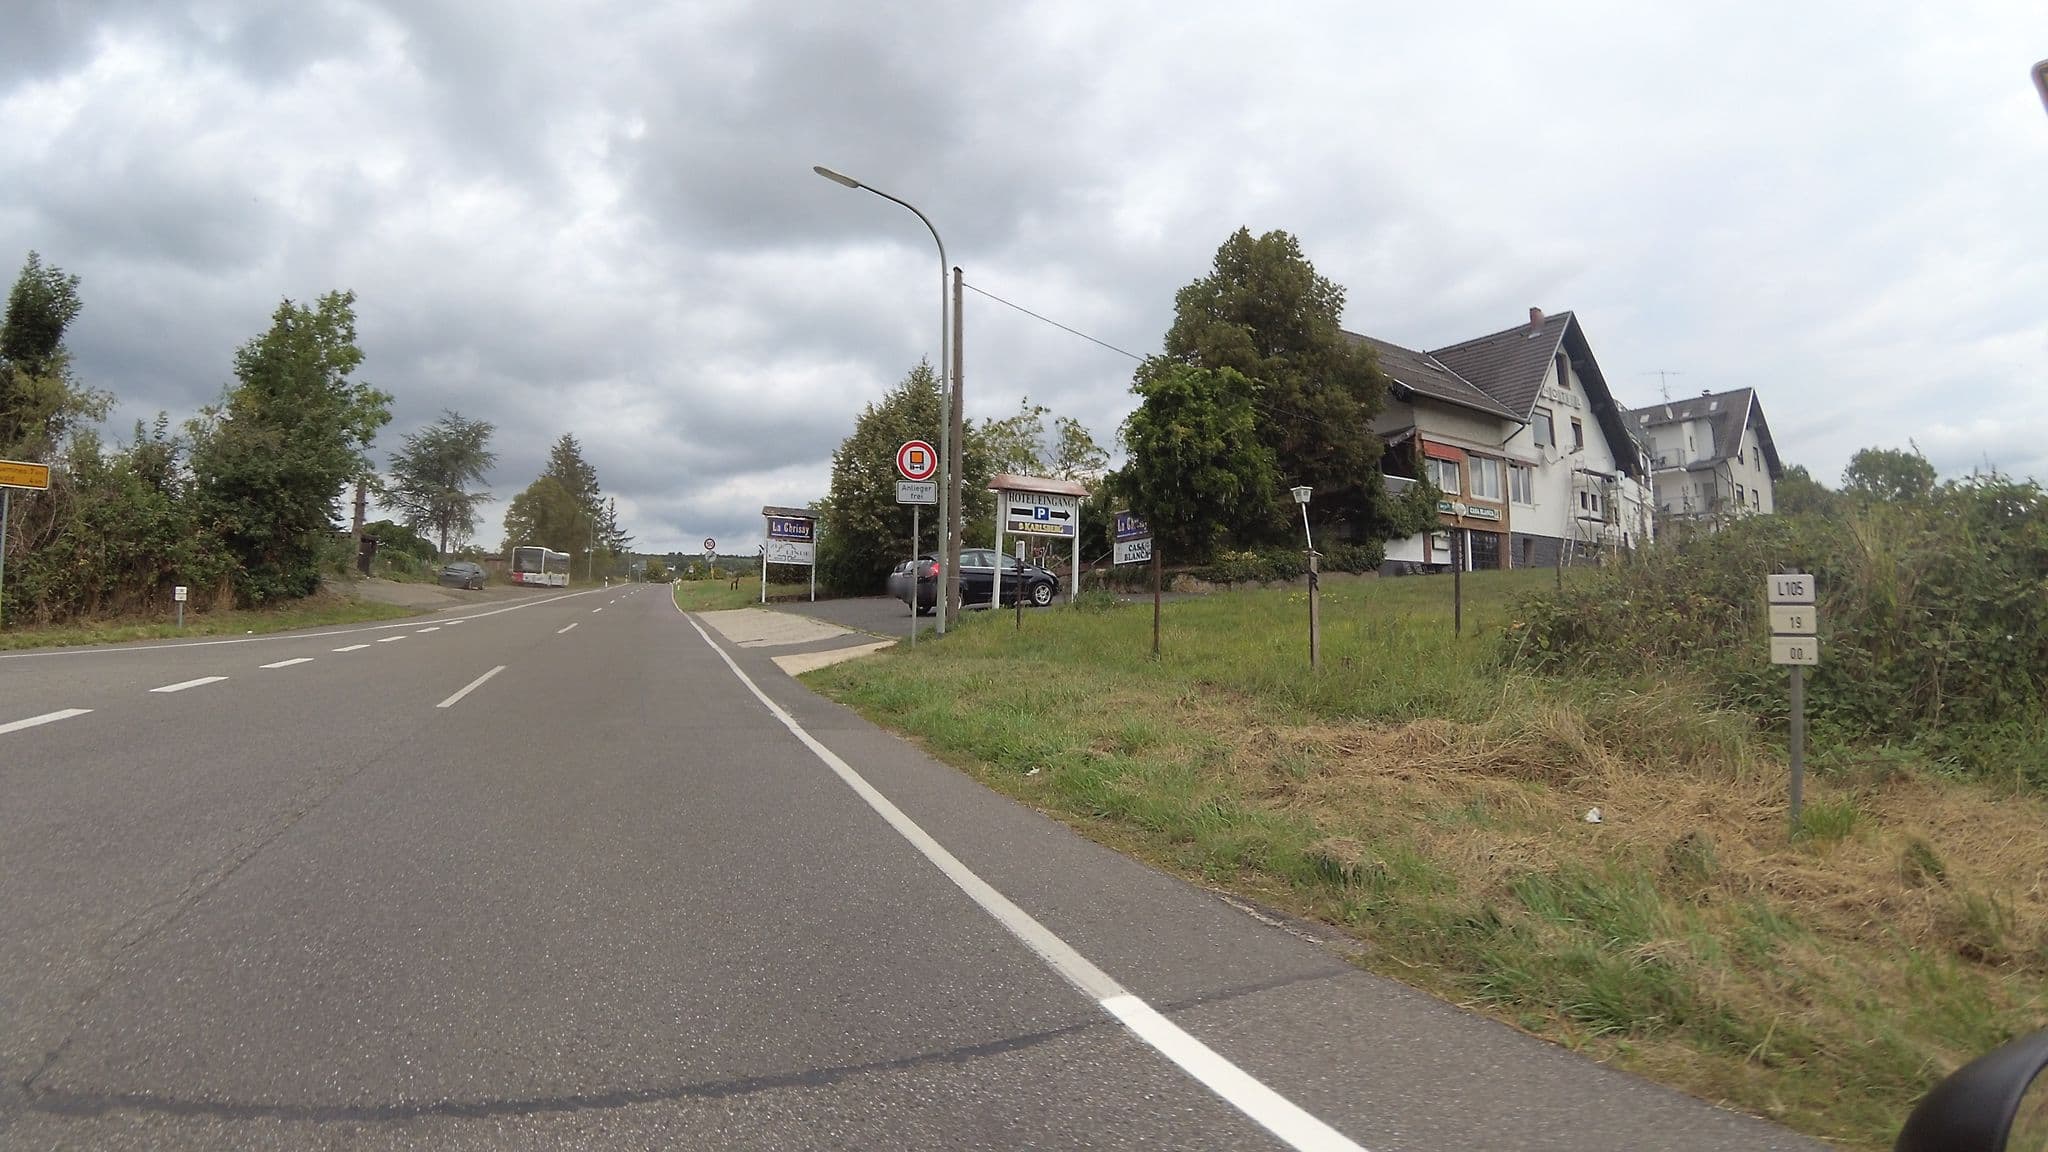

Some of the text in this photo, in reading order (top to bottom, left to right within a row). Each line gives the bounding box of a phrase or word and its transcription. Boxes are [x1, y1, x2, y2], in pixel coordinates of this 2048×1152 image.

[902, 484, 932, 494] Anlieger
[1009, 492, 1074, 508] HOTEL EINGANG
[1038, 508, 1046, 519] P
[772, 521, 781, 532] La
[1128, 542, 1146, 552] CASA
[1790, 616, 1802, 629] 19
[1790, 647, 1803, 660] 00
